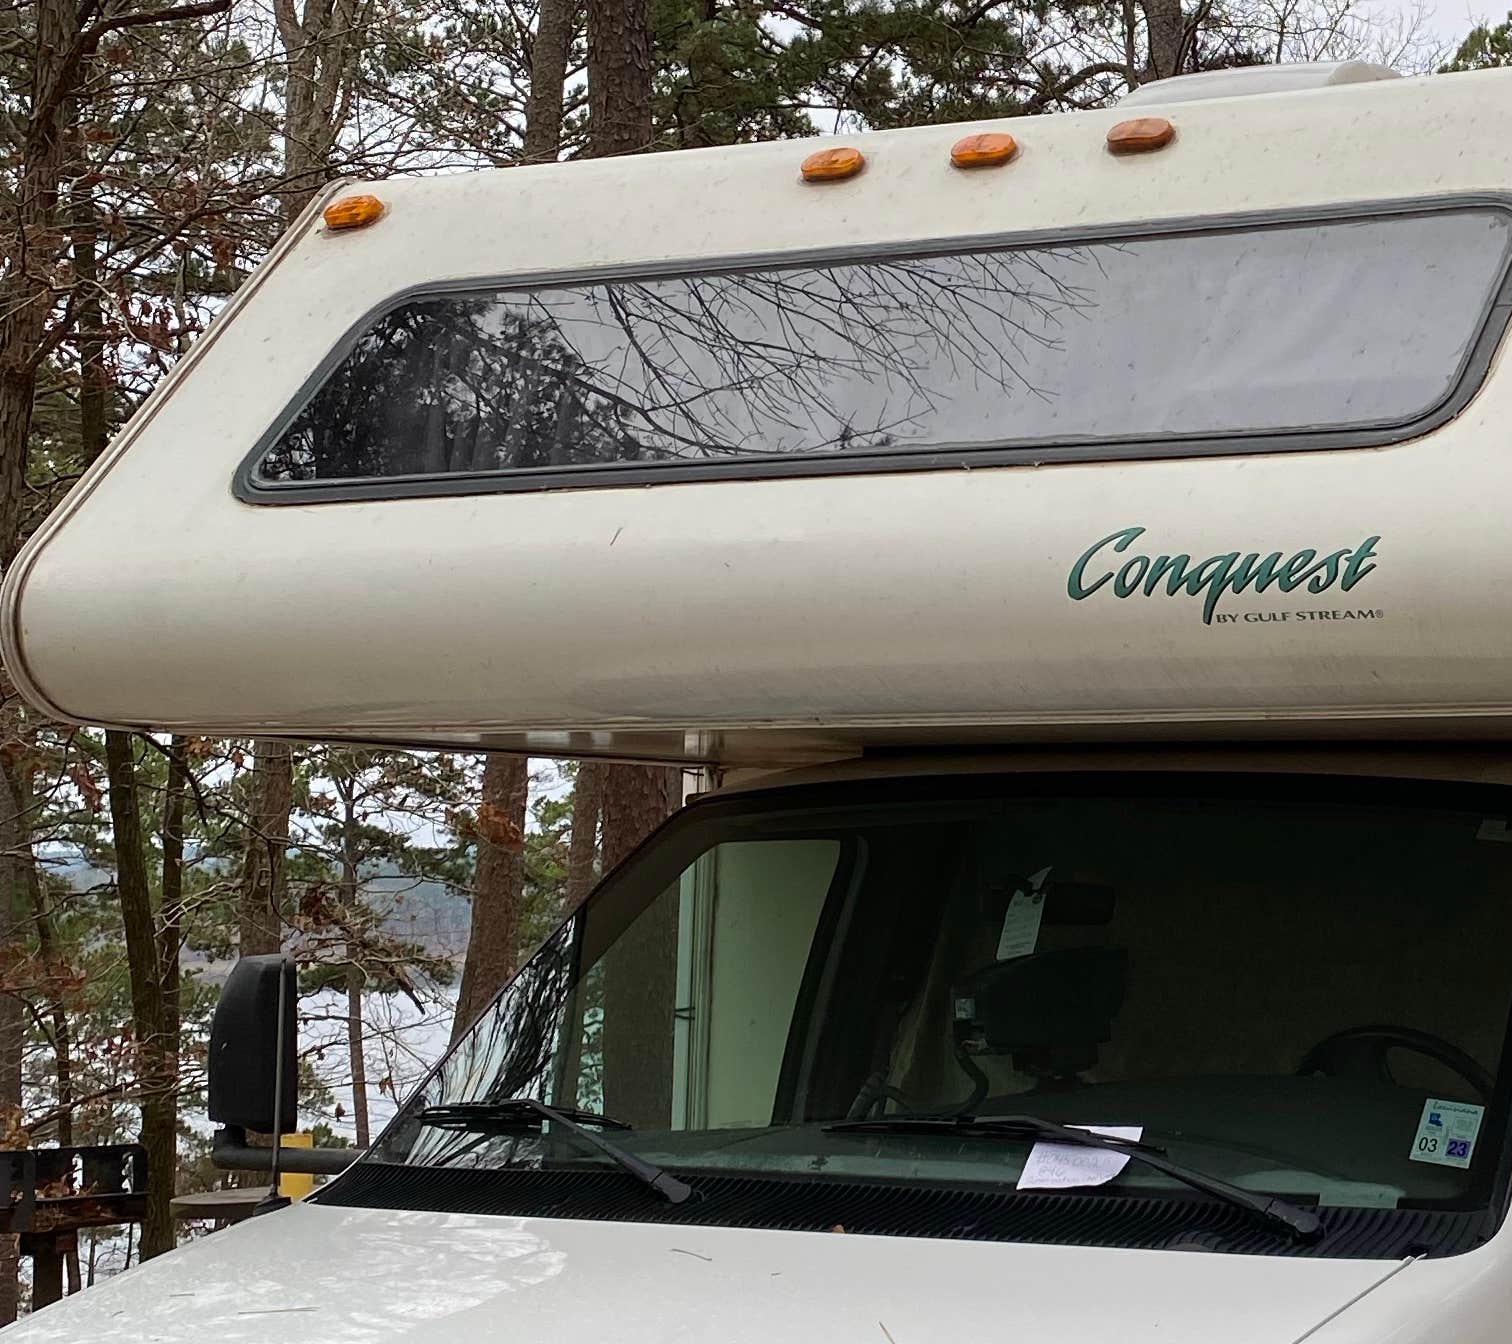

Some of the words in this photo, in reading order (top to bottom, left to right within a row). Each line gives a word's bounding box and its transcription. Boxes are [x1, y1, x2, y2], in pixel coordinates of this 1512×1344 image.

[1067, 526, 1382, 625] Conquest
[1216, 613, 1239, 624] BY
[1244, 611, 1291, 623] GULF
[1418, 1136, 1438, 1153] 03
[1447, 1140, 1468, 1157] 23
